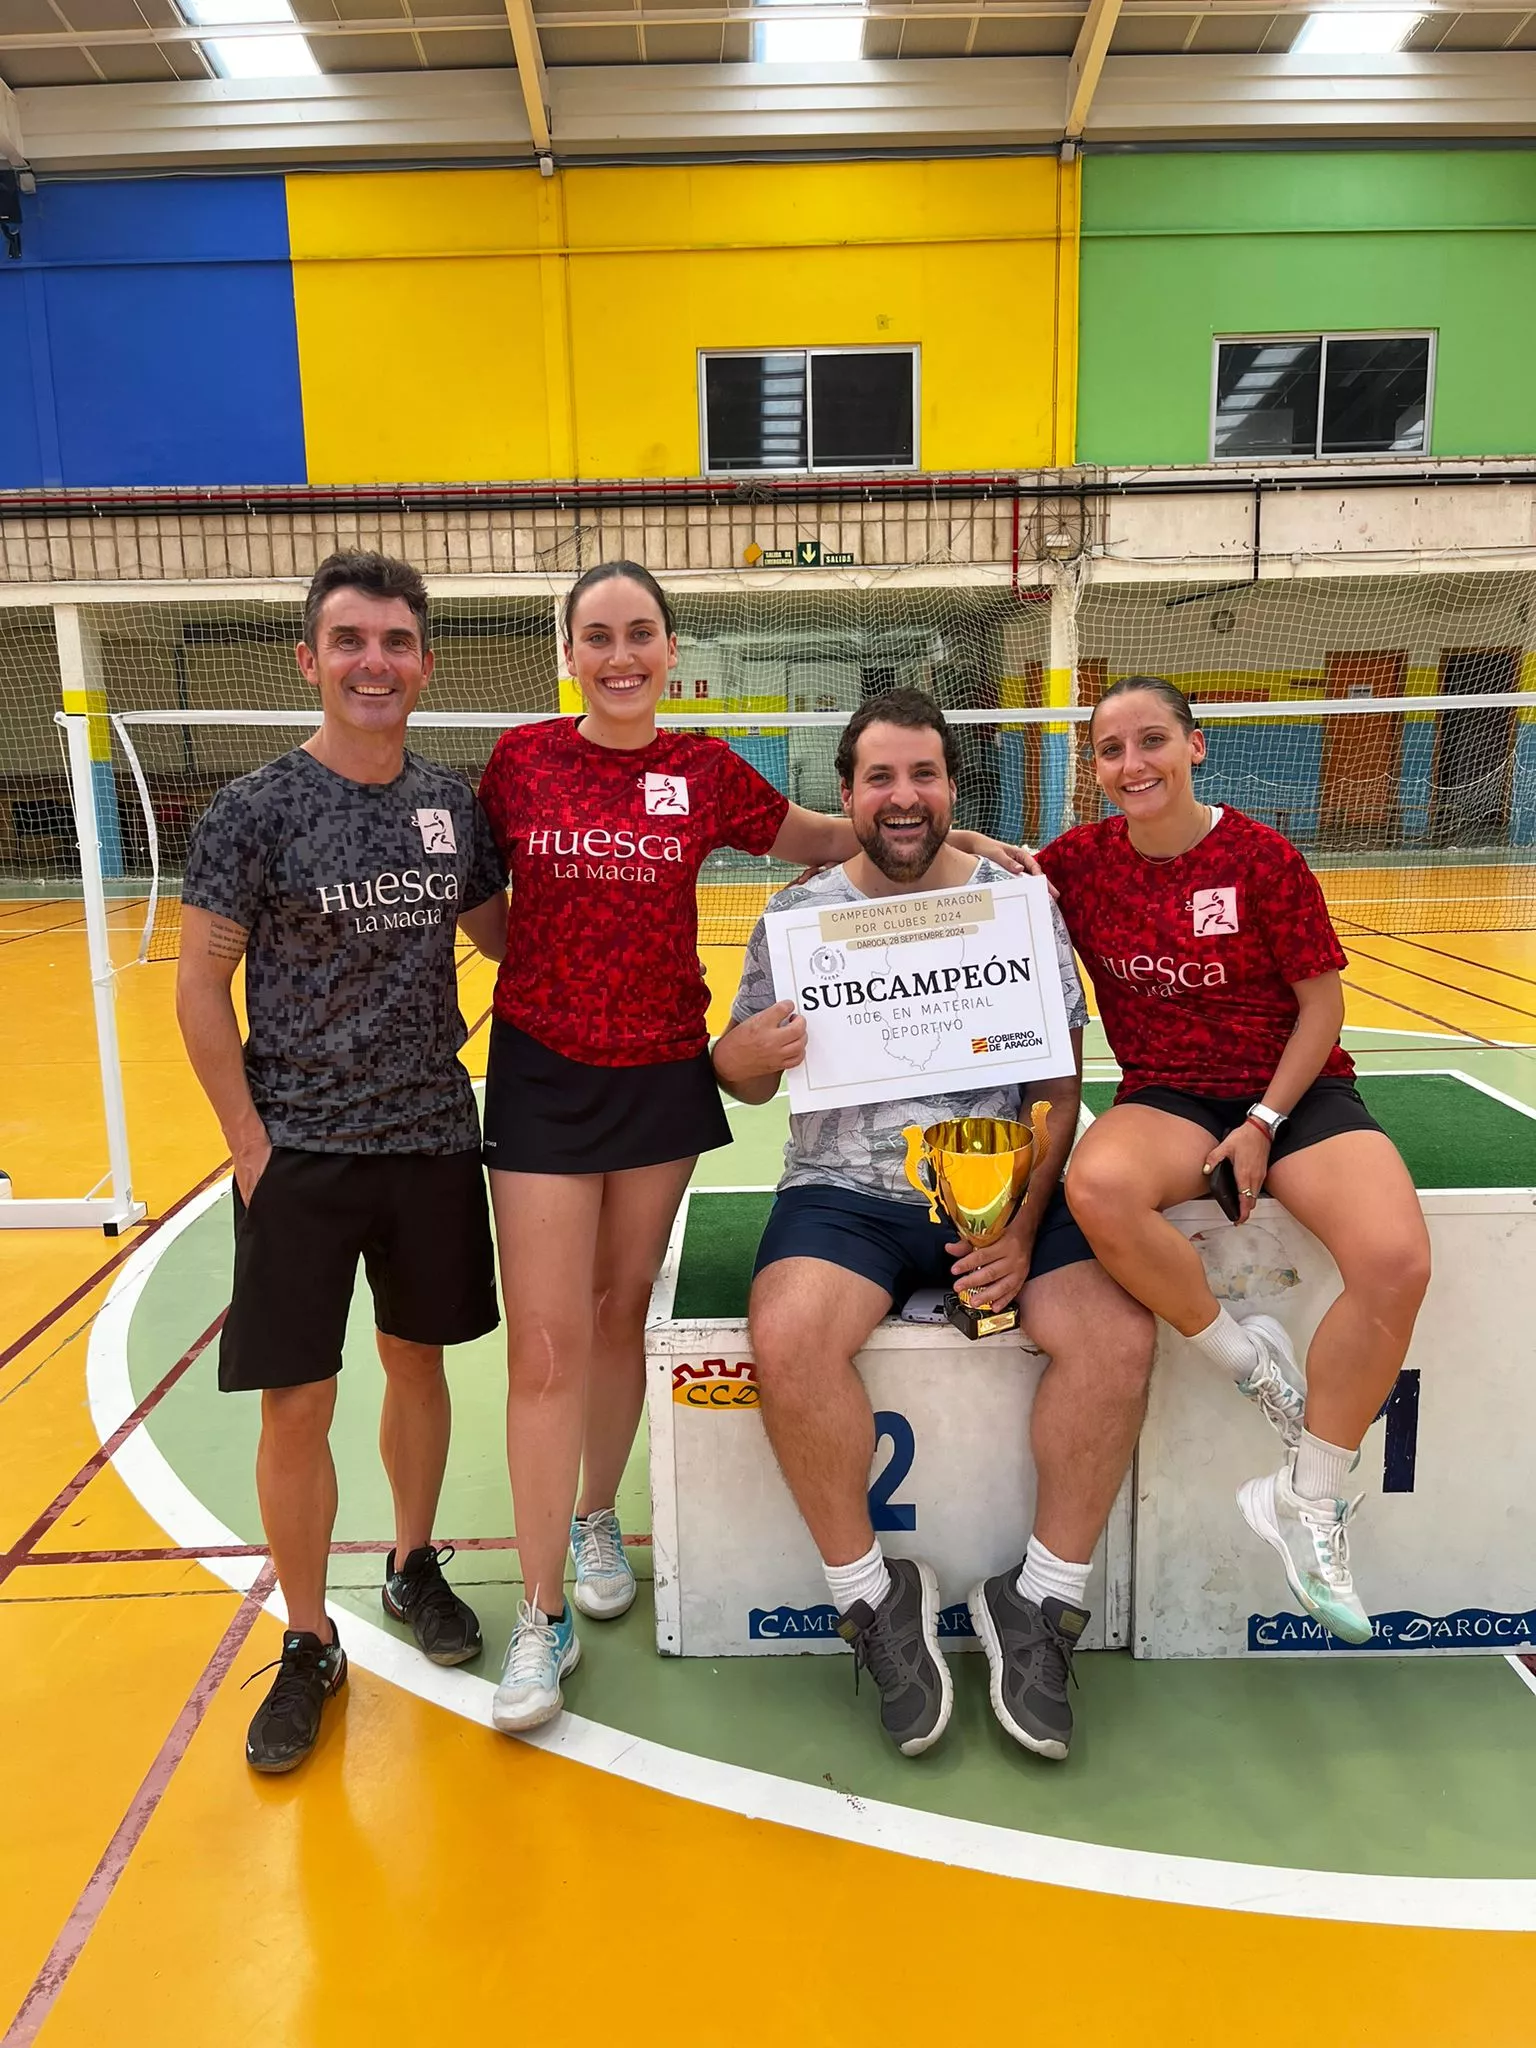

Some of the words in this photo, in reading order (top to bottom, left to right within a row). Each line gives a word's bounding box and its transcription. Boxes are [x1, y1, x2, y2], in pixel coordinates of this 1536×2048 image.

[825, 554, 852, 563] SALIDA
[526, 828, 683, 863] Huesca
[315, 870, 459, 915] Huesca
[831, 904, 907, 923] CAMPEONATO
[914, 900, 929, 912] DE
[936, 892, 983, 908] ARAGÓN
[854, 922, 877, 934] POR
[884, 916, 927, 930] CLUBES
[934, 911, 962, 924] 2024
[856, 938, 889, 950] DAROCA,
[889, 935, 900, 945] 28
[900, 930, 944, 944] SEPTIEMBRE
[944, 927, 965, 937] 2024
[801, 954, 1032, 1012] SUBCAMPEÓN
[892, 1007, 911, 1020] EN
[921, 996, 994, 1015] MATERIAL
[882, 1018, 964, 1041] DEPORTIVO
[988, 1030, 1035, 1044] GOBIERNO
[988, 1043, 1001, 1052] DE
[686, 1384, 760, 1405] CCD
[1371, 1368, 1421, 1493] 1
[867, 1410, 917, 1531] 2
[758, 1613, 840, 1638] CAMP
[1255, 1621, 1333, 1645] CAM
